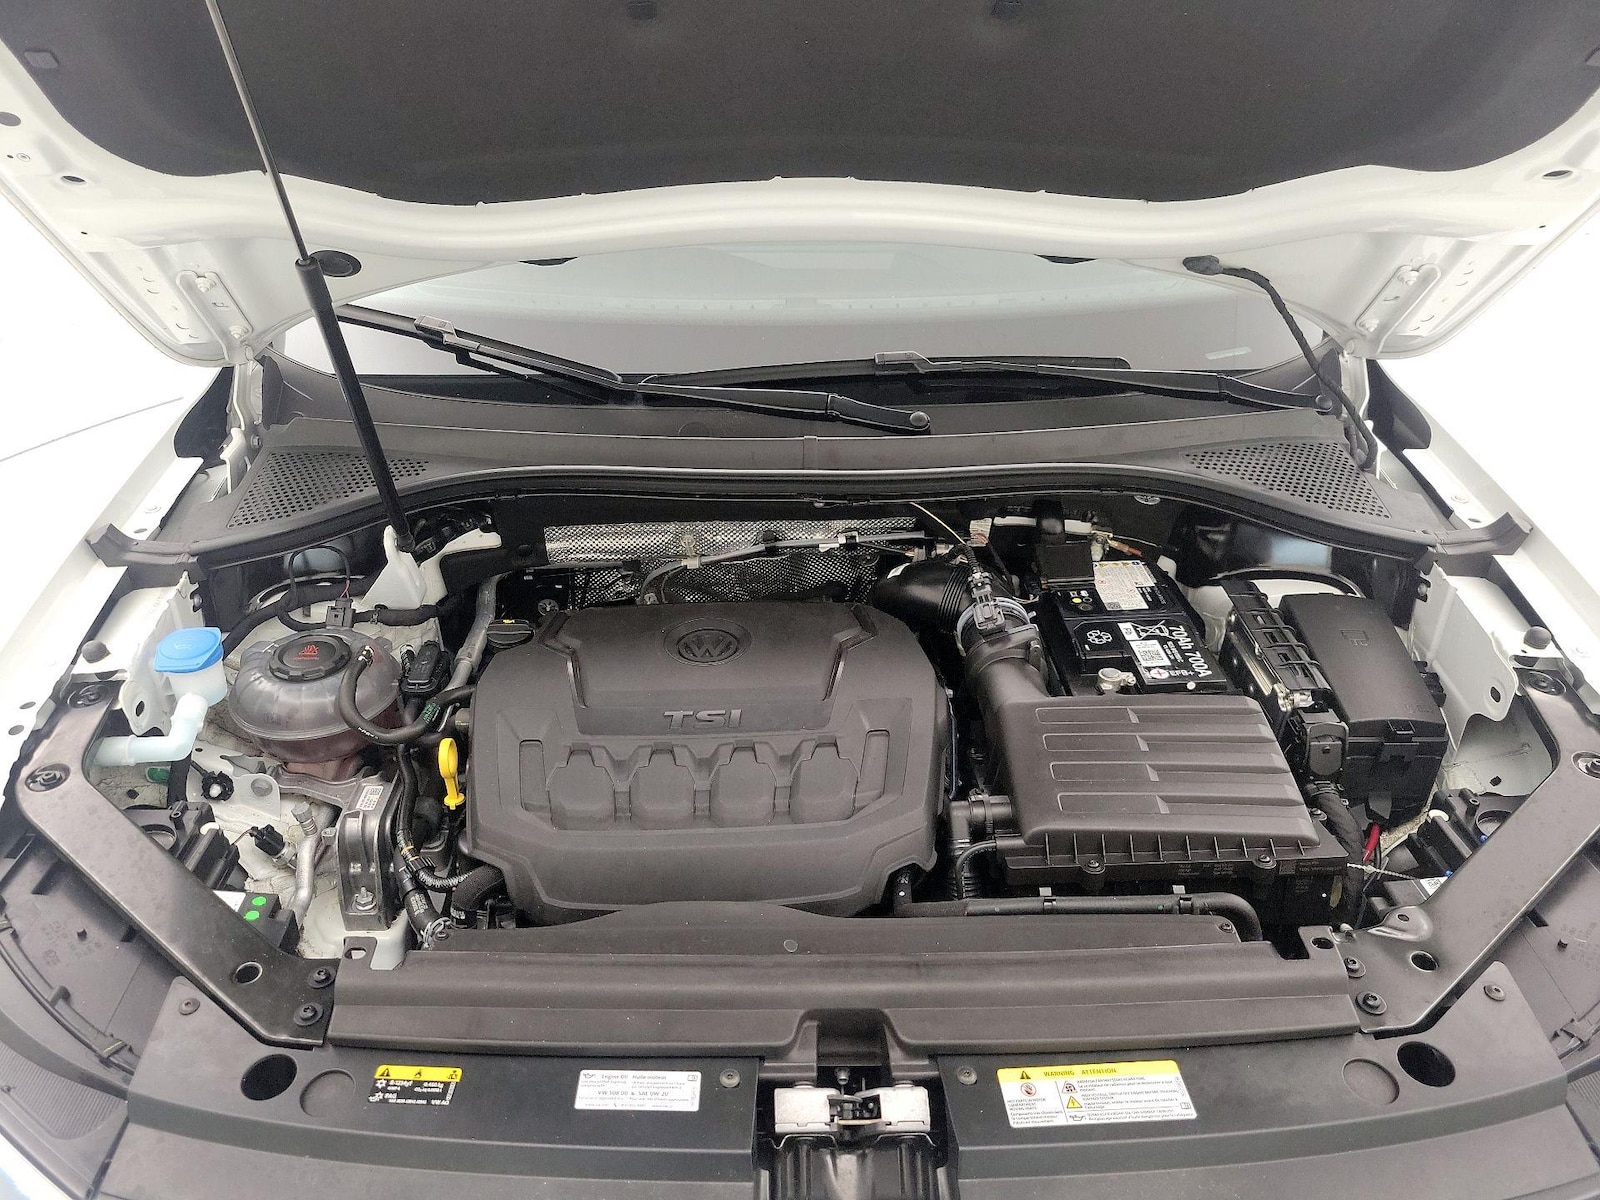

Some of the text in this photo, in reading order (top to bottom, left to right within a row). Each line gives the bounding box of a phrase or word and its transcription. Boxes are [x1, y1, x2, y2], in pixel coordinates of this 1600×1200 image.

[1168, 625, 1194, 649] 70Ah
[1184, 651, 1212, 677] 700A
[663, 709, 742, 729] TSI
[1043, 1069, 1075, 1077] WARNING
